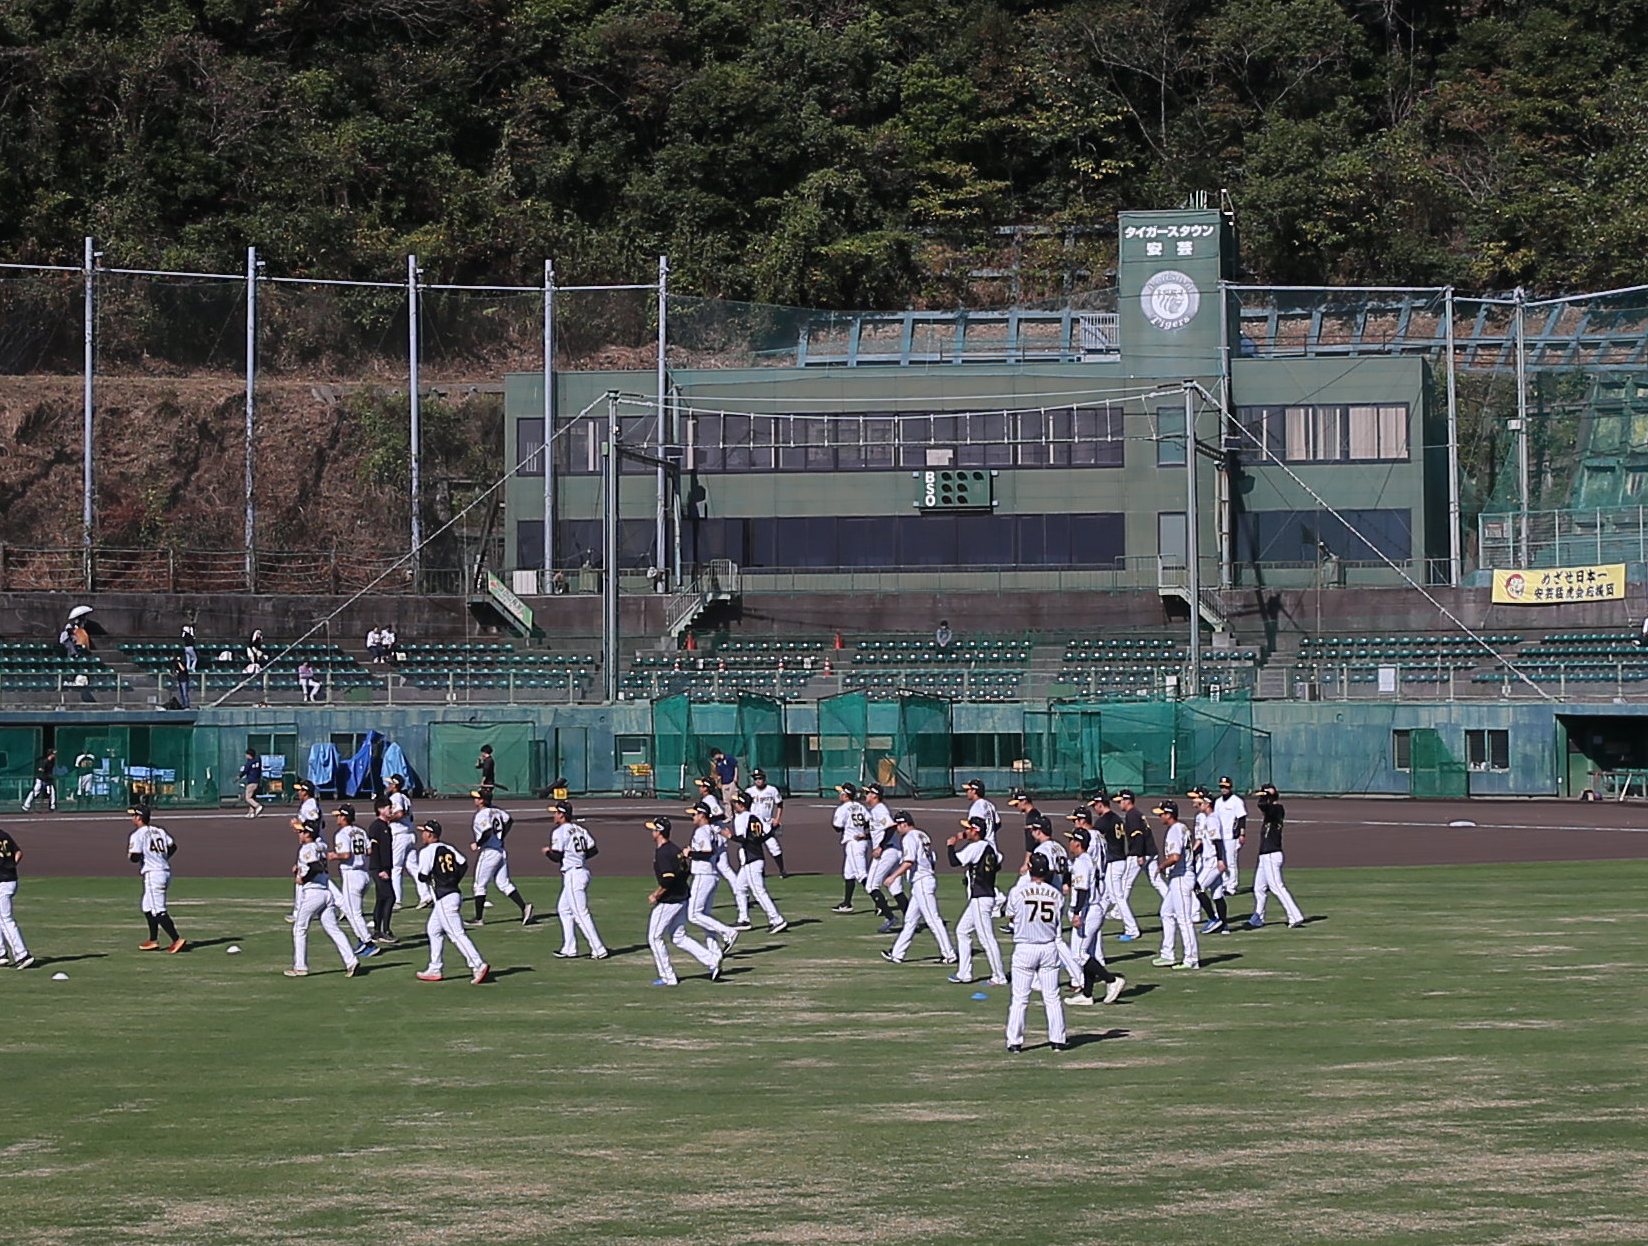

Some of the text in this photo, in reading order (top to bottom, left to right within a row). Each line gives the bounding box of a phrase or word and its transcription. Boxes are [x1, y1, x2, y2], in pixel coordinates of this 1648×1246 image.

[1124, 224, 1214, 239] タイガースタウン
[1150, 314, 1191, 330] Tigers
[1541, 569, 1608, 585] めざせ日本一
[149, 837, 165, 853] 40
[573, 835, 587, 853] 20
[1024, 900, 1055, 923] 75
